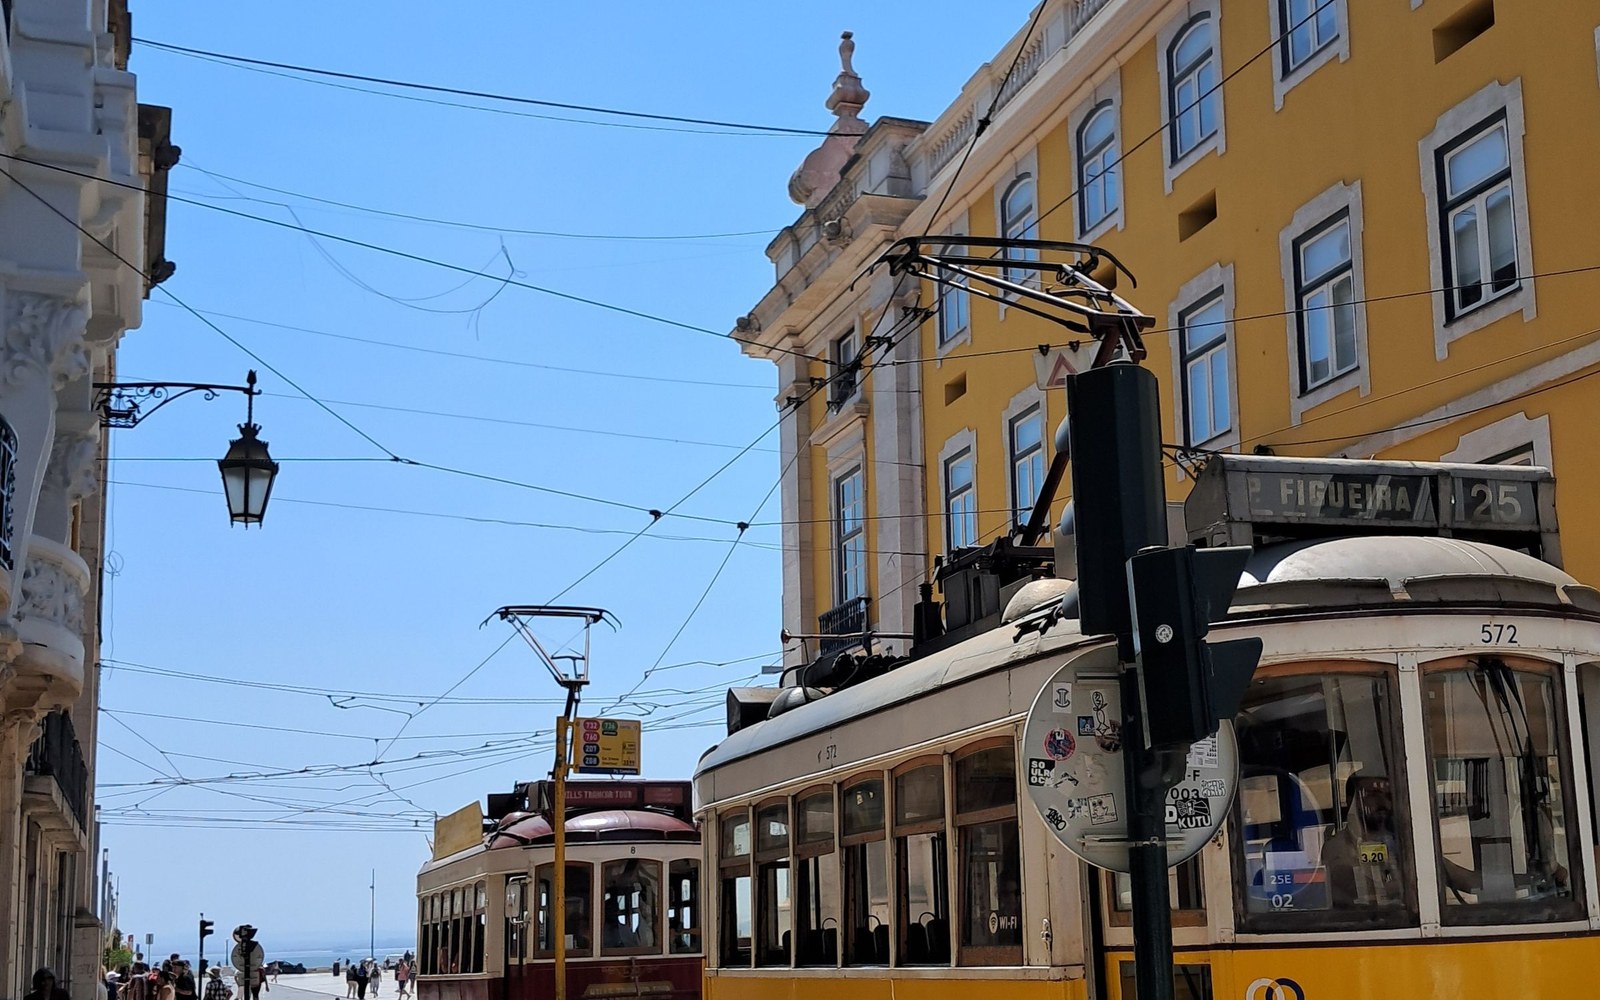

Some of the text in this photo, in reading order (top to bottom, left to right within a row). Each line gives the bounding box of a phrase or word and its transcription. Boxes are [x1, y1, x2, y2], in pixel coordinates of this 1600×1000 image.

[1280, 478, 1412, 512] FIGUEIRA
[1470, 484, 1523, 522] 25
[1481, 624, 1518, 643] 572
[585, 733, 598, 742] 760
[826, 744, 837, 760] 572
[615, 790, 632, 799] TOUR
[1178, 816, 1211, 828] KUTU
[630, 846, 636, 854] 8
[1361, 852, 1384, 863] 3.20
[1270, 874, 1292, 885] 25E
[1272, 894, 1294, 908] 02
[999, 915, 1017, 929] WI-FI
